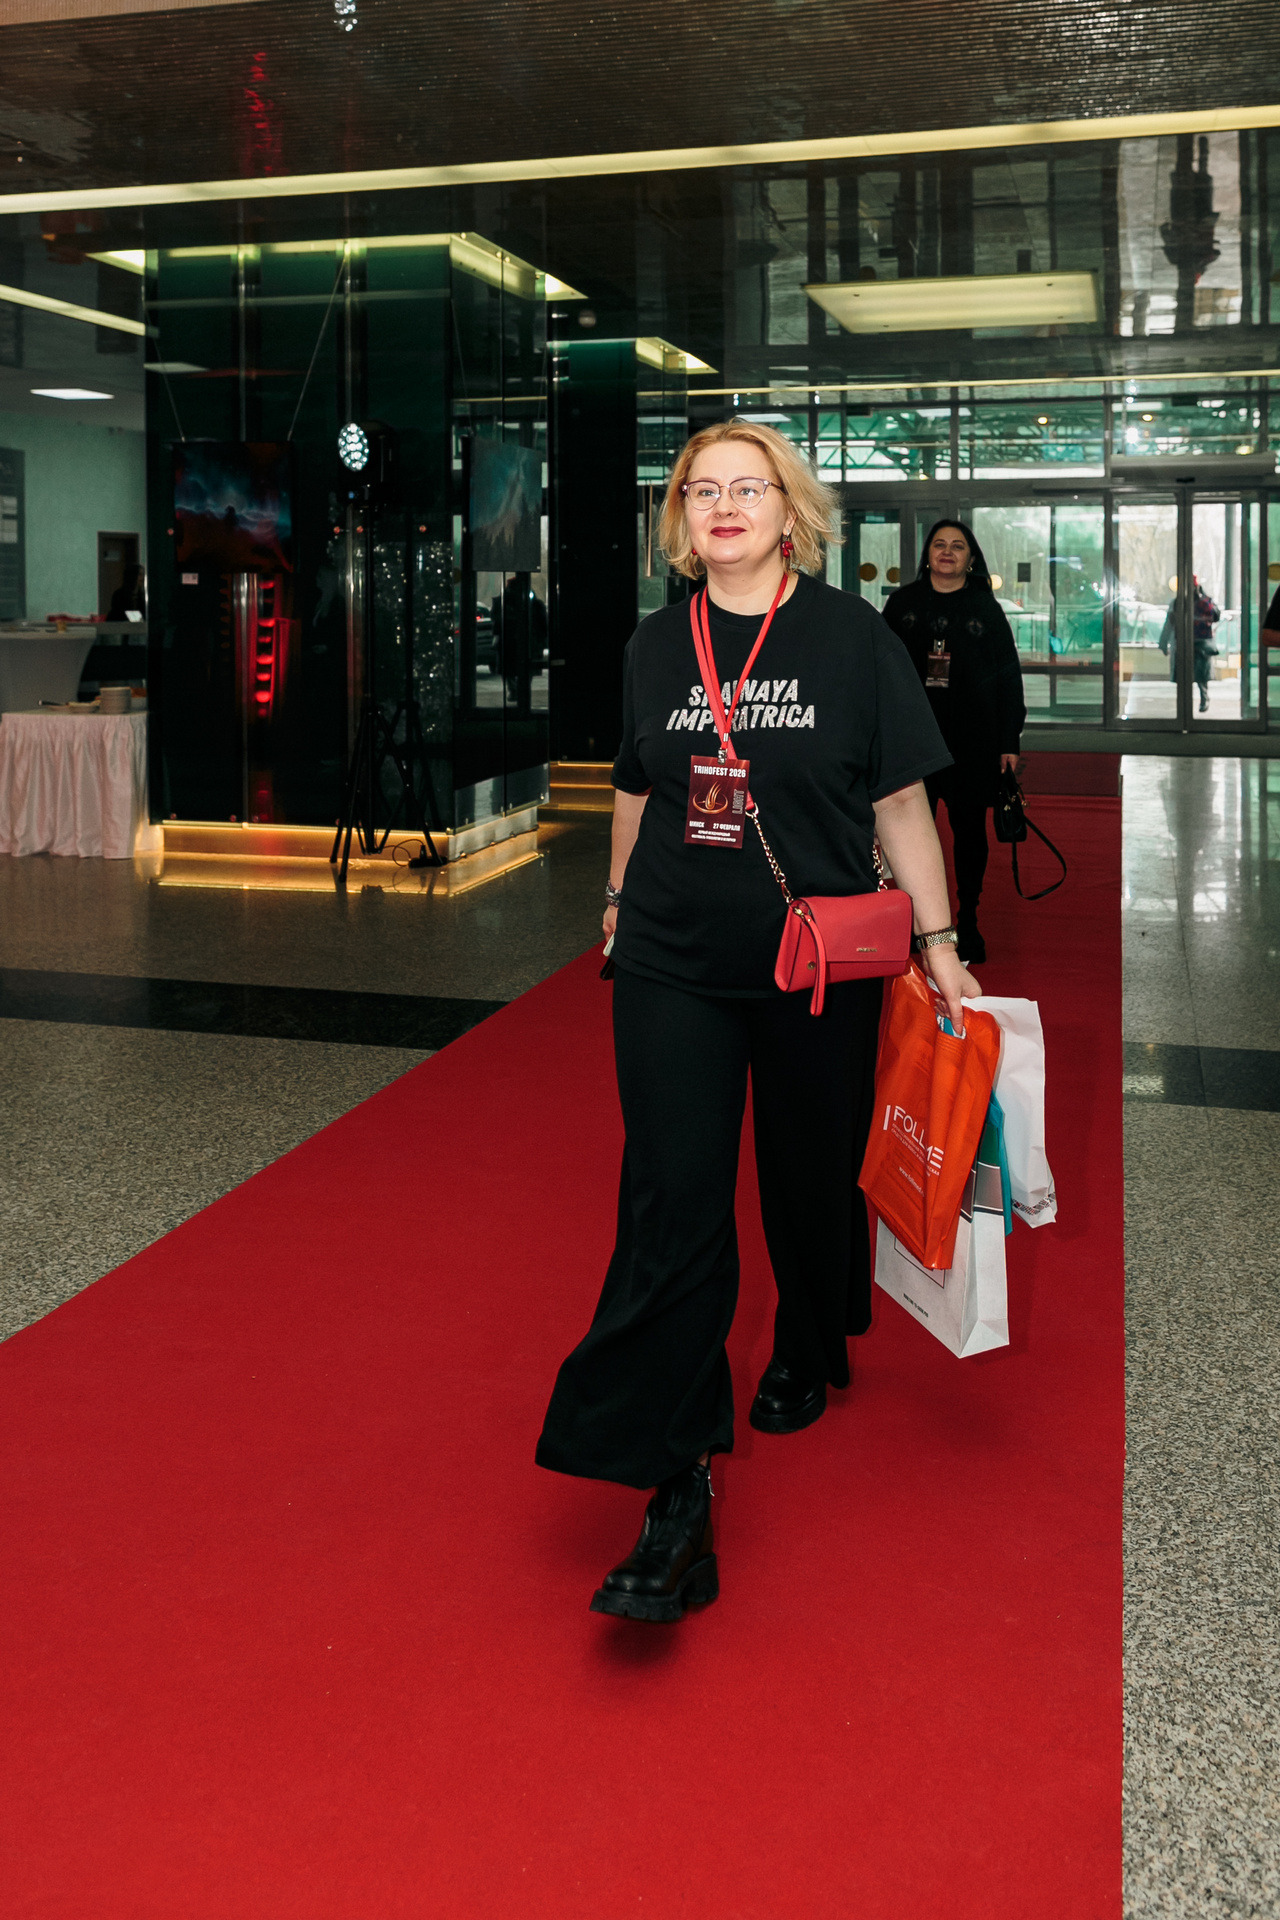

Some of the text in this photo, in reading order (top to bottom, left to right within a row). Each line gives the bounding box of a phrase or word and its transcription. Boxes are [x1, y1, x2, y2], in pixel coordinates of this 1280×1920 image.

[688, 679, 798, 707] SANAYA
[666, 704, 815, 733] IMPATRICA
[693, 765, 746, 778] TRIHOFEST 2026
